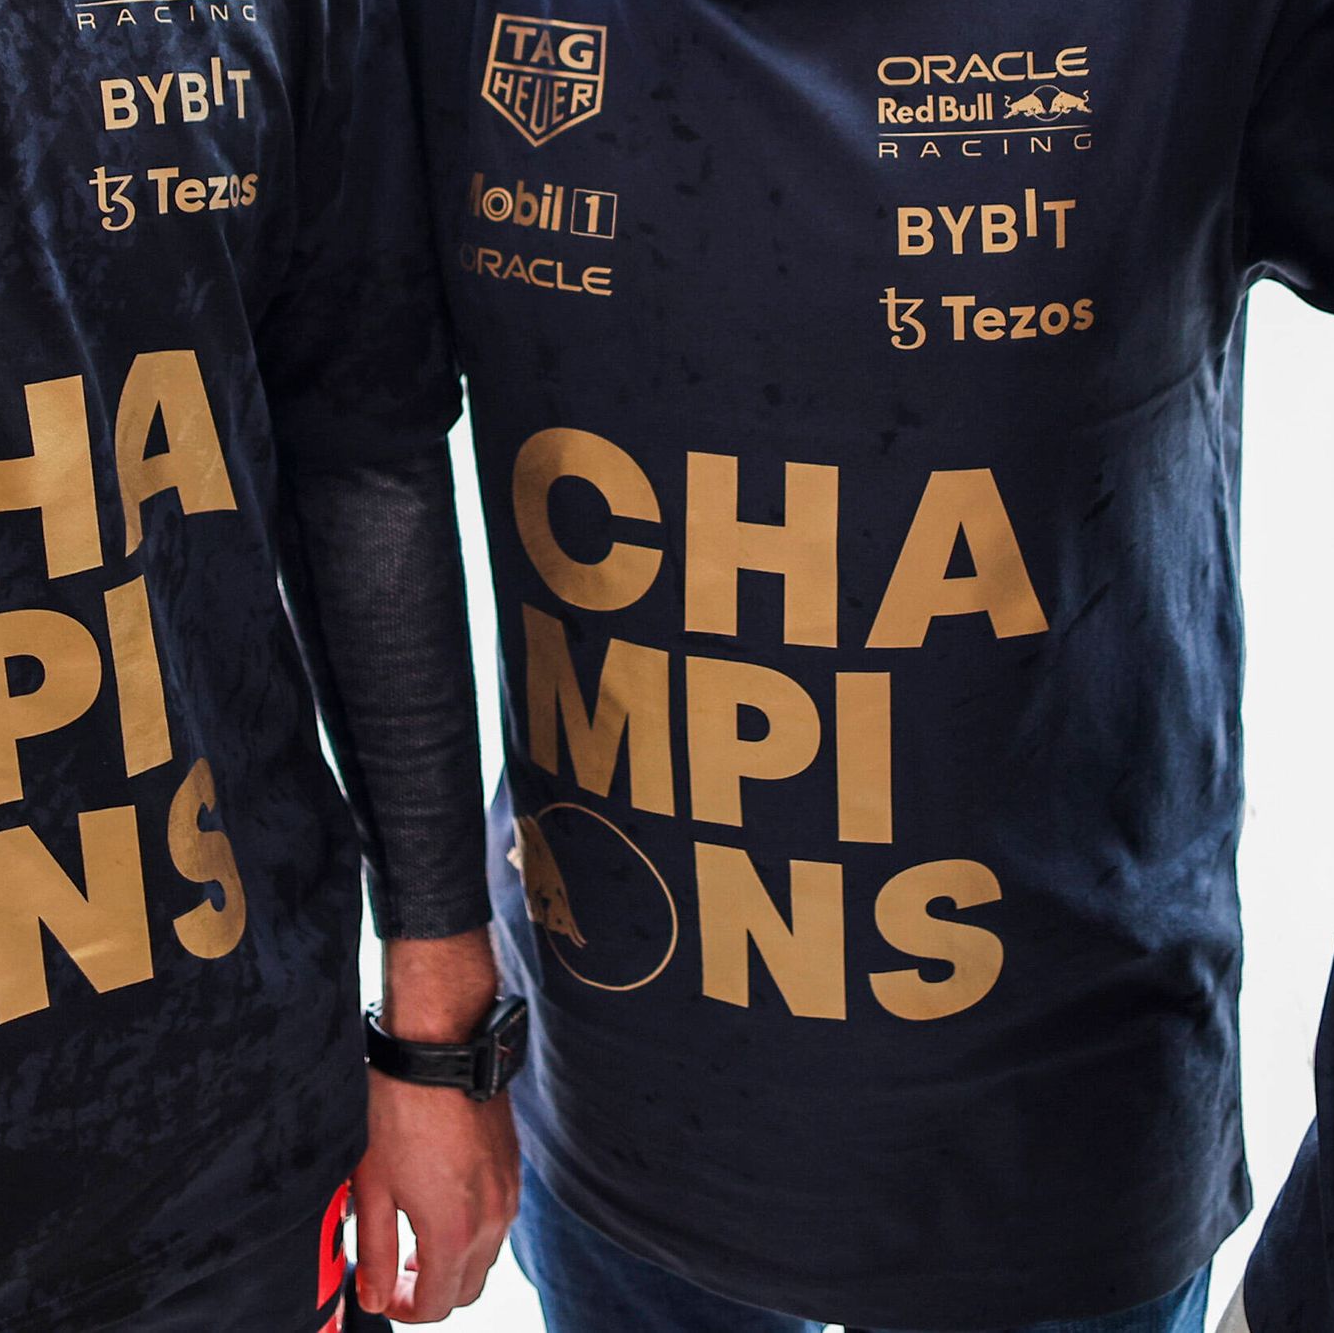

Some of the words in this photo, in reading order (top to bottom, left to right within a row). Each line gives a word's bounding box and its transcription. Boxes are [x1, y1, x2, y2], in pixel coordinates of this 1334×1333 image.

[76, 4, 257, 31] RACING
[506, 26, 595, 68] TAG
[877, 46, 1090, 86] ORACLE
[100, 57, 252, 131] BYBIT
[493, 75, 593, 135] HEUER
[878, 132, 1093, 159] RACING
[148, 166, 258, 216] Tezos
[896, 188, 1077, 257] BYBIT
[460, 242, 613, 296] ORACLE
[940, 293, 1095, 342] Tezos
[511, 426, 1051, 649] CHA
[521, 601, 894, 844] MPI
